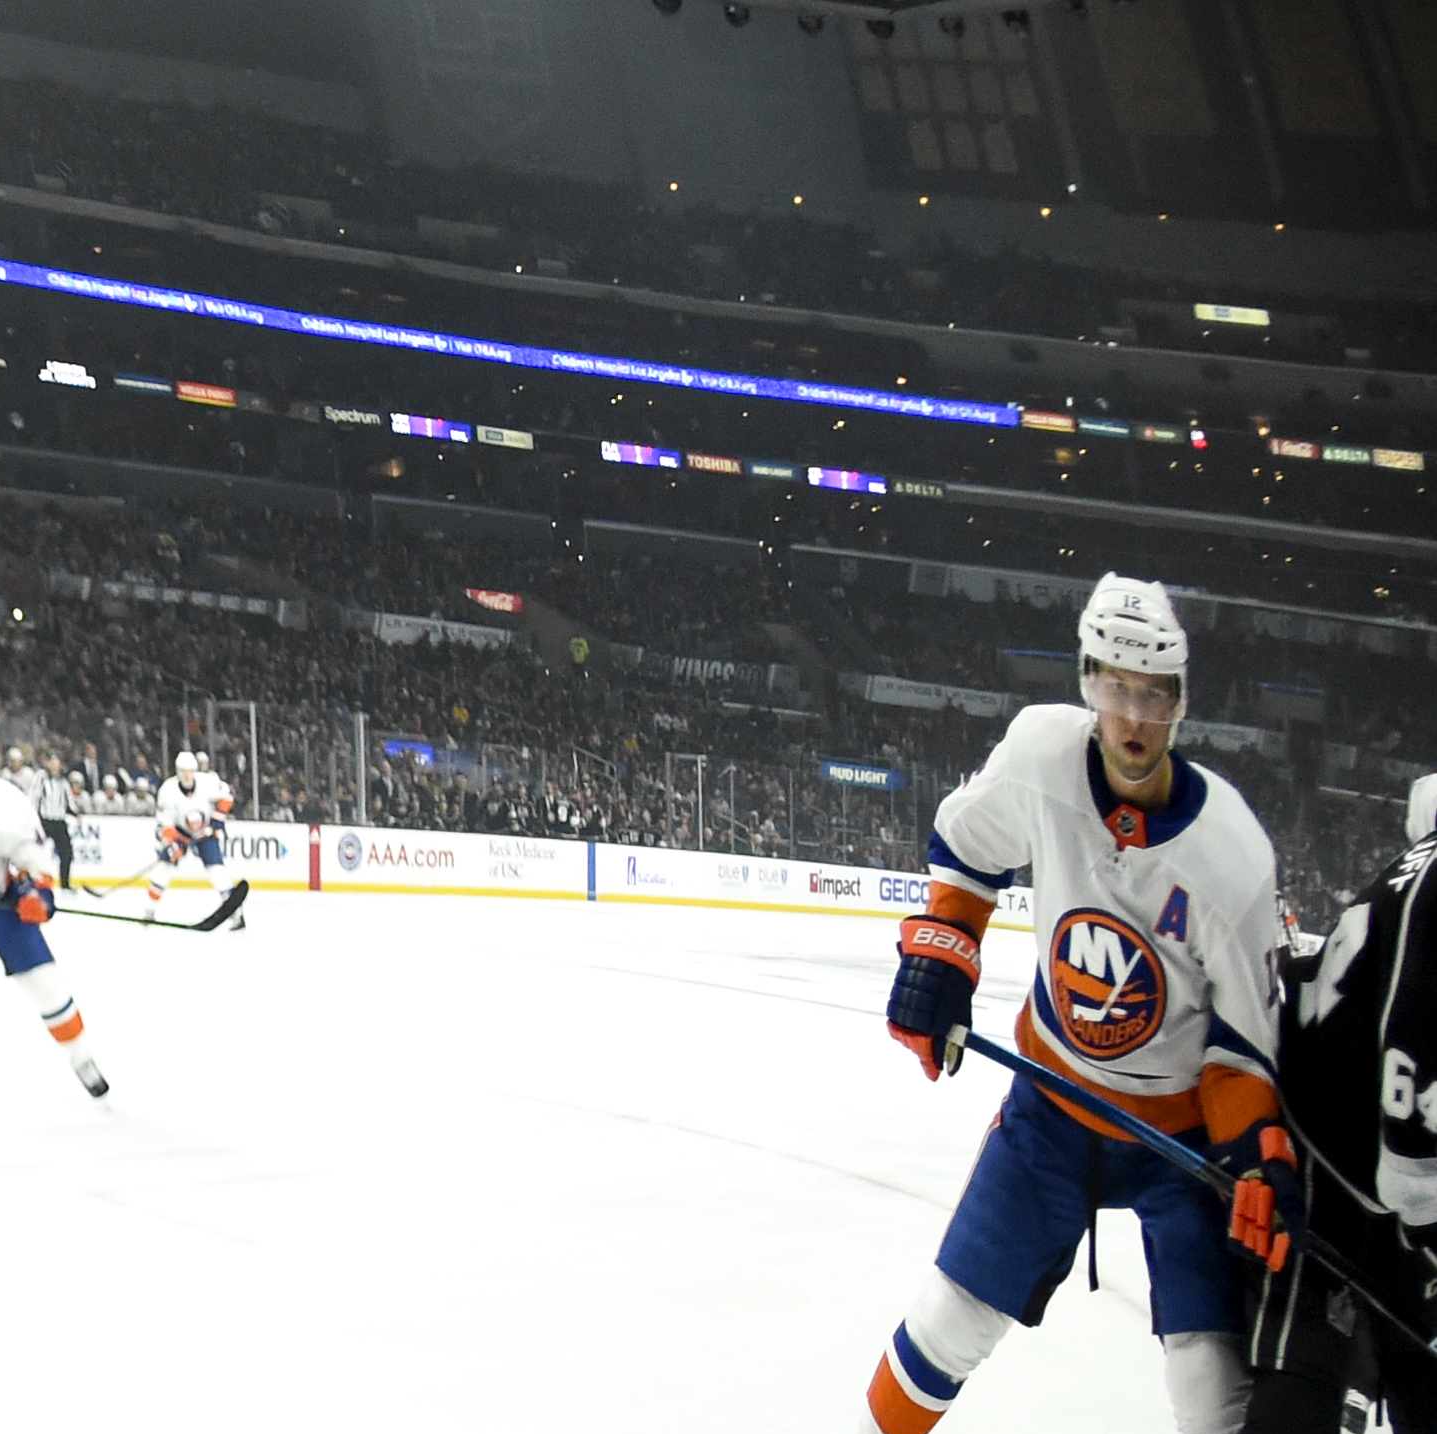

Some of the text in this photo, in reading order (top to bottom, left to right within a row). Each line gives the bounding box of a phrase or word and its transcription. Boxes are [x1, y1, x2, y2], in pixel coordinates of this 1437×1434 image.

[324, 405, 381, 426] Spectrum
[687, 453, 741, 474] TOSHIBA
[905, 483, 943, 497] DELTA
[1123, 594, 1142, 611] 12
[1113, 635, 1149, 650] CCM
[829, 765, 888, 785] BUD LIGHT
[367, 842, 455, 869] AAA.com
[718, 862, 740, 880] blue
[758, 865, 779, 882] blue
[819, 868, 861, 900] impact
[1155, 885, 1190, 943] A
